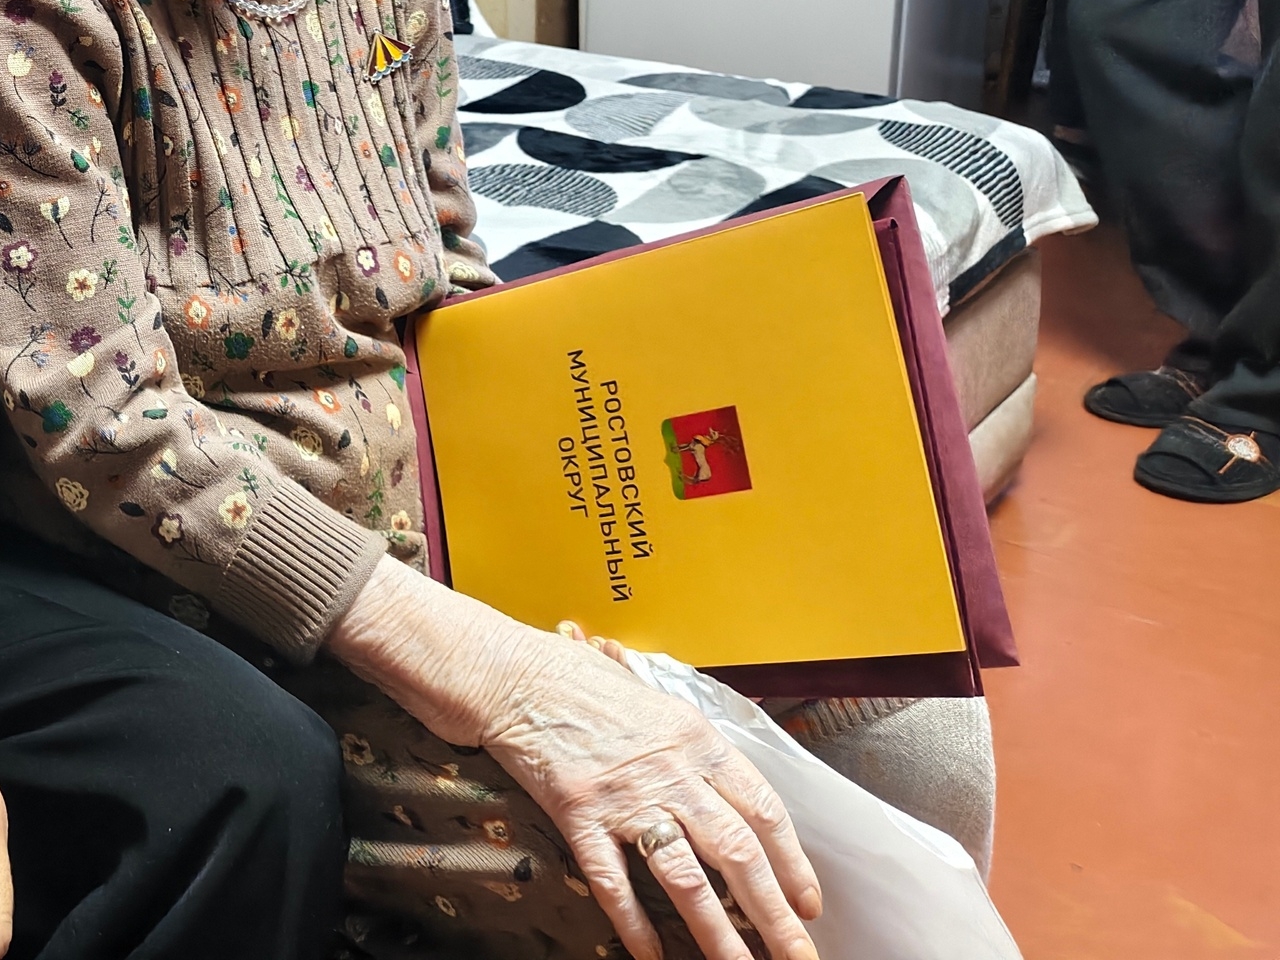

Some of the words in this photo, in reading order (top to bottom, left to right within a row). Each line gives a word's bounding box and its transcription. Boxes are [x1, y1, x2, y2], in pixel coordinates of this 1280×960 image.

[558, 436, 589, 518] ОКРУГ
[567, 349, 633, 602] МУНИЦИПАЛЬНЫЙ
[600, 380, 654, 559] РОСТОВСКИЙ
